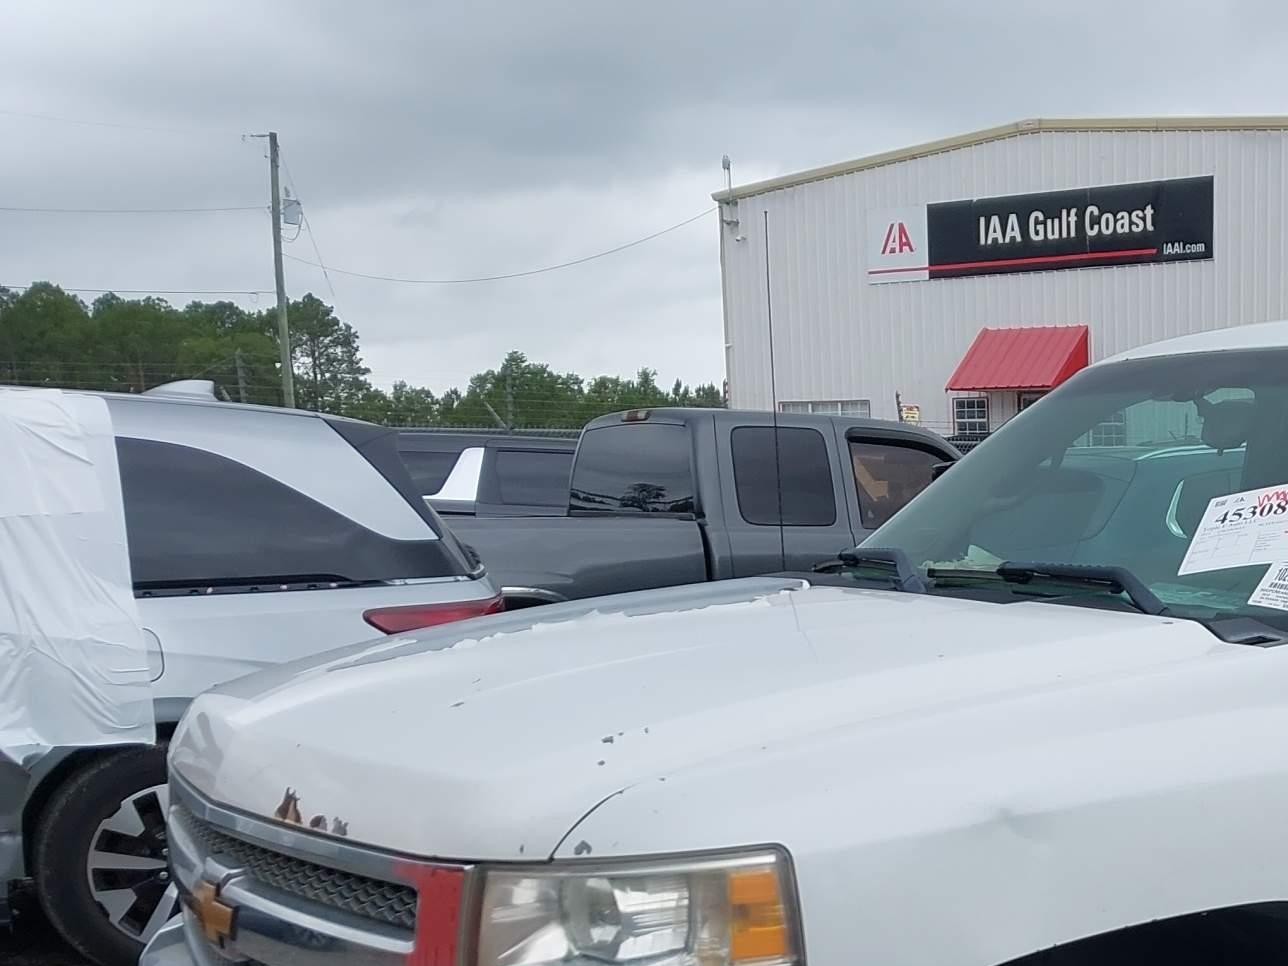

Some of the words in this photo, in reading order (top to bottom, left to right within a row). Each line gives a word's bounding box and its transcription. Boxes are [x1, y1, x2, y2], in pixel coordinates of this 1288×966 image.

[979, 213, 1022, 245] IAA
[1029, 207, 1077, 241] Gulf
[1085, 203, 1154, 236] Coast
[1163, 241, 1205, 255] IAAI.com
